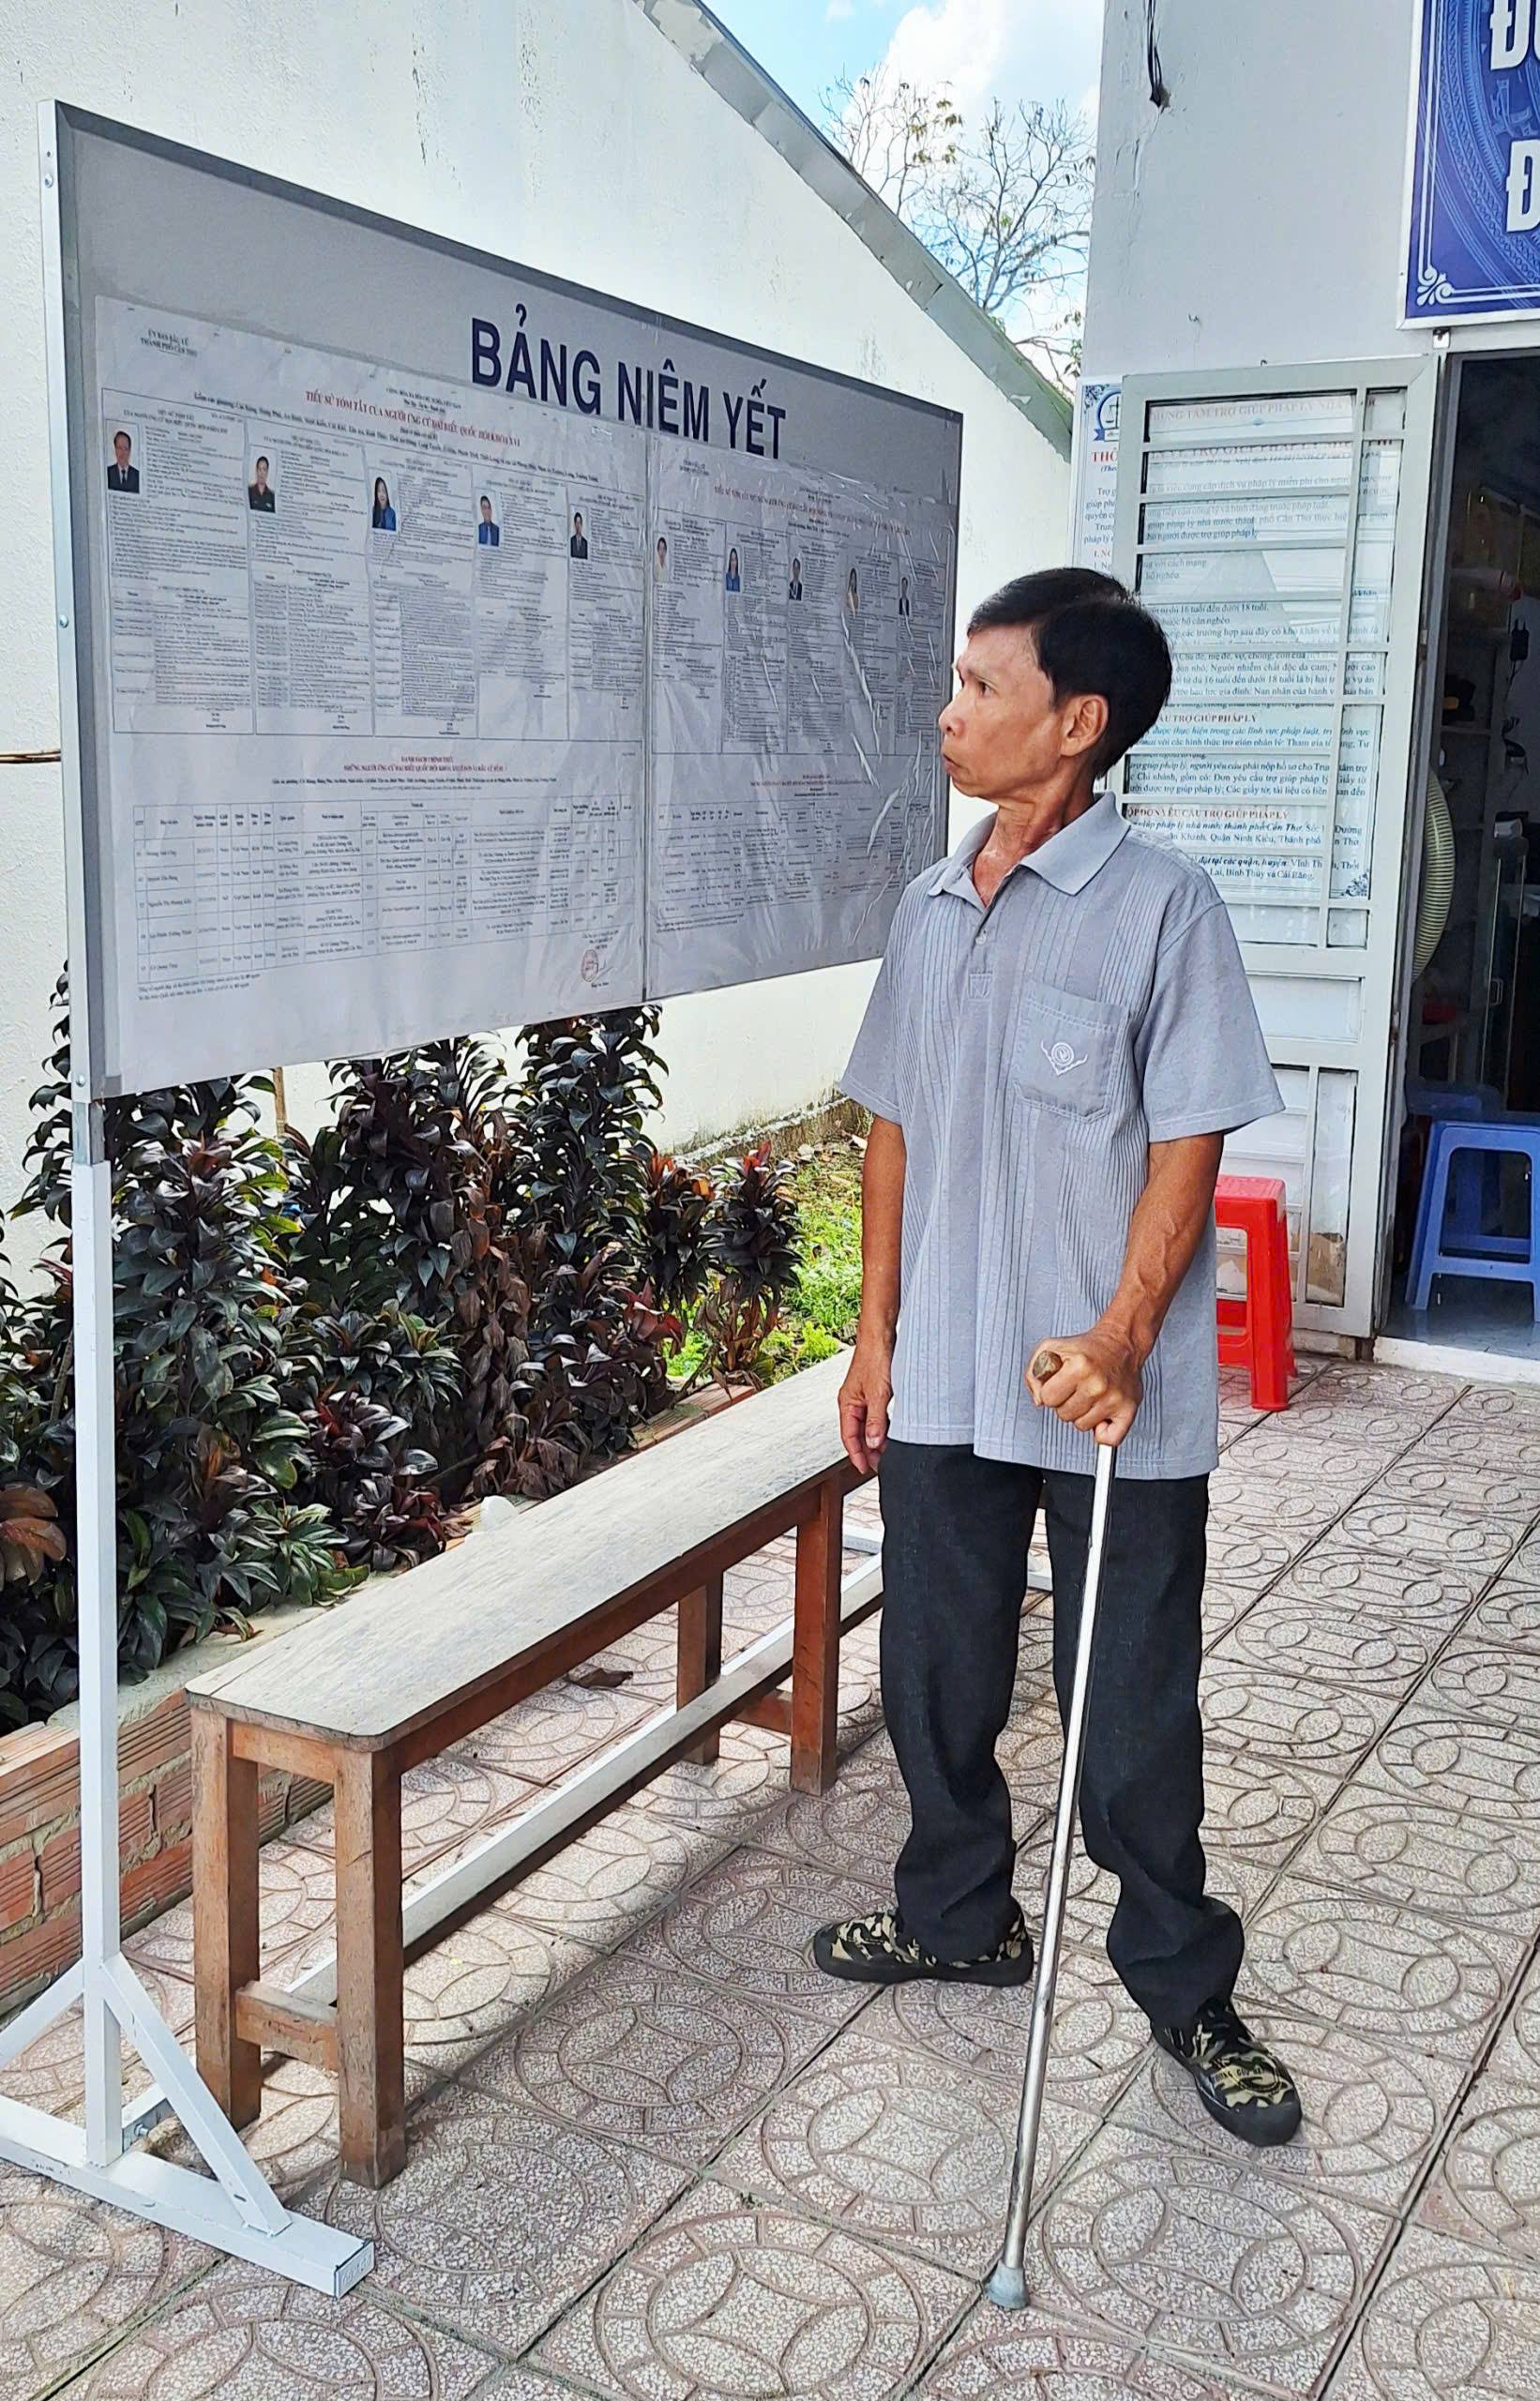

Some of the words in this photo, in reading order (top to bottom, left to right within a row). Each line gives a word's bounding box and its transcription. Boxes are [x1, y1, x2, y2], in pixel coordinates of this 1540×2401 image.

[1489, 0, 1540, 70] Đ
[472, 303, 601, 416] BẢNG
[617, 358, 709, 443] NIÊM
[722, 378, 786, 460] YẾT
